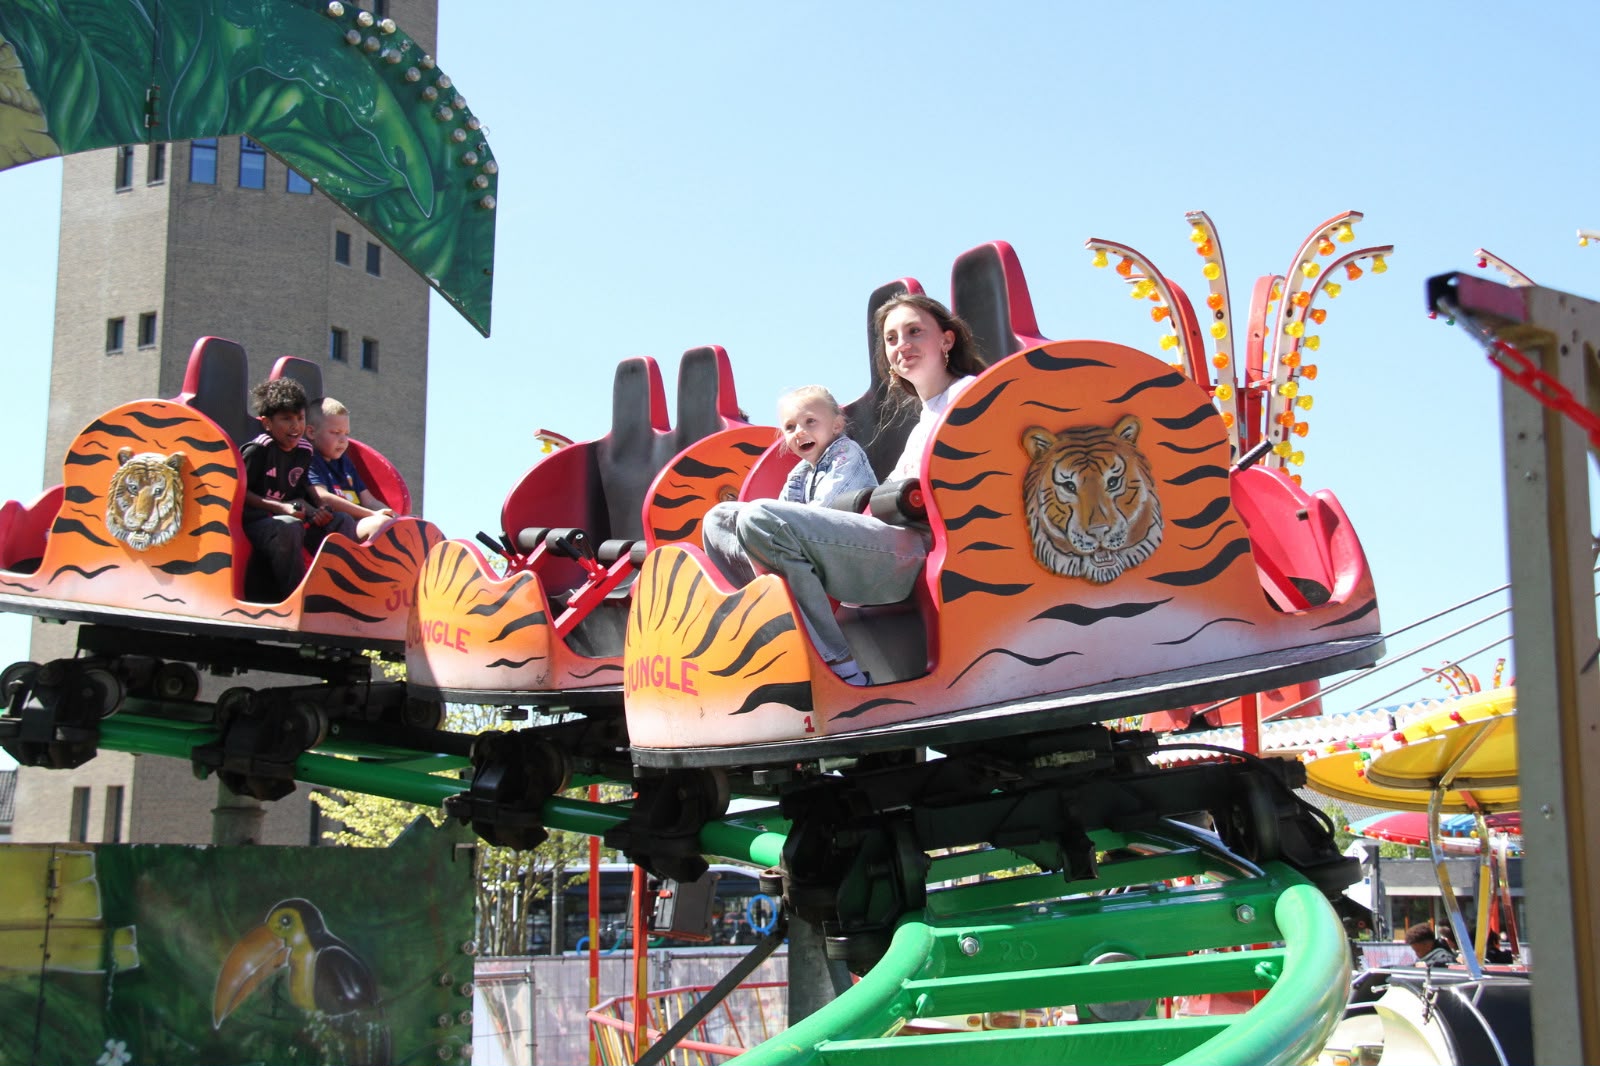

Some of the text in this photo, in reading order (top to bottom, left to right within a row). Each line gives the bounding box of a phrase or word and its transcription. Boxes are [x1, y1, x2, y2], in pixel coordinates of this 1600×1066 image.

[407, 619, 472, 655] JUNGLE
[625, 654, 700, 699] JUNGLE
[803, 715, 816, 733] 1
